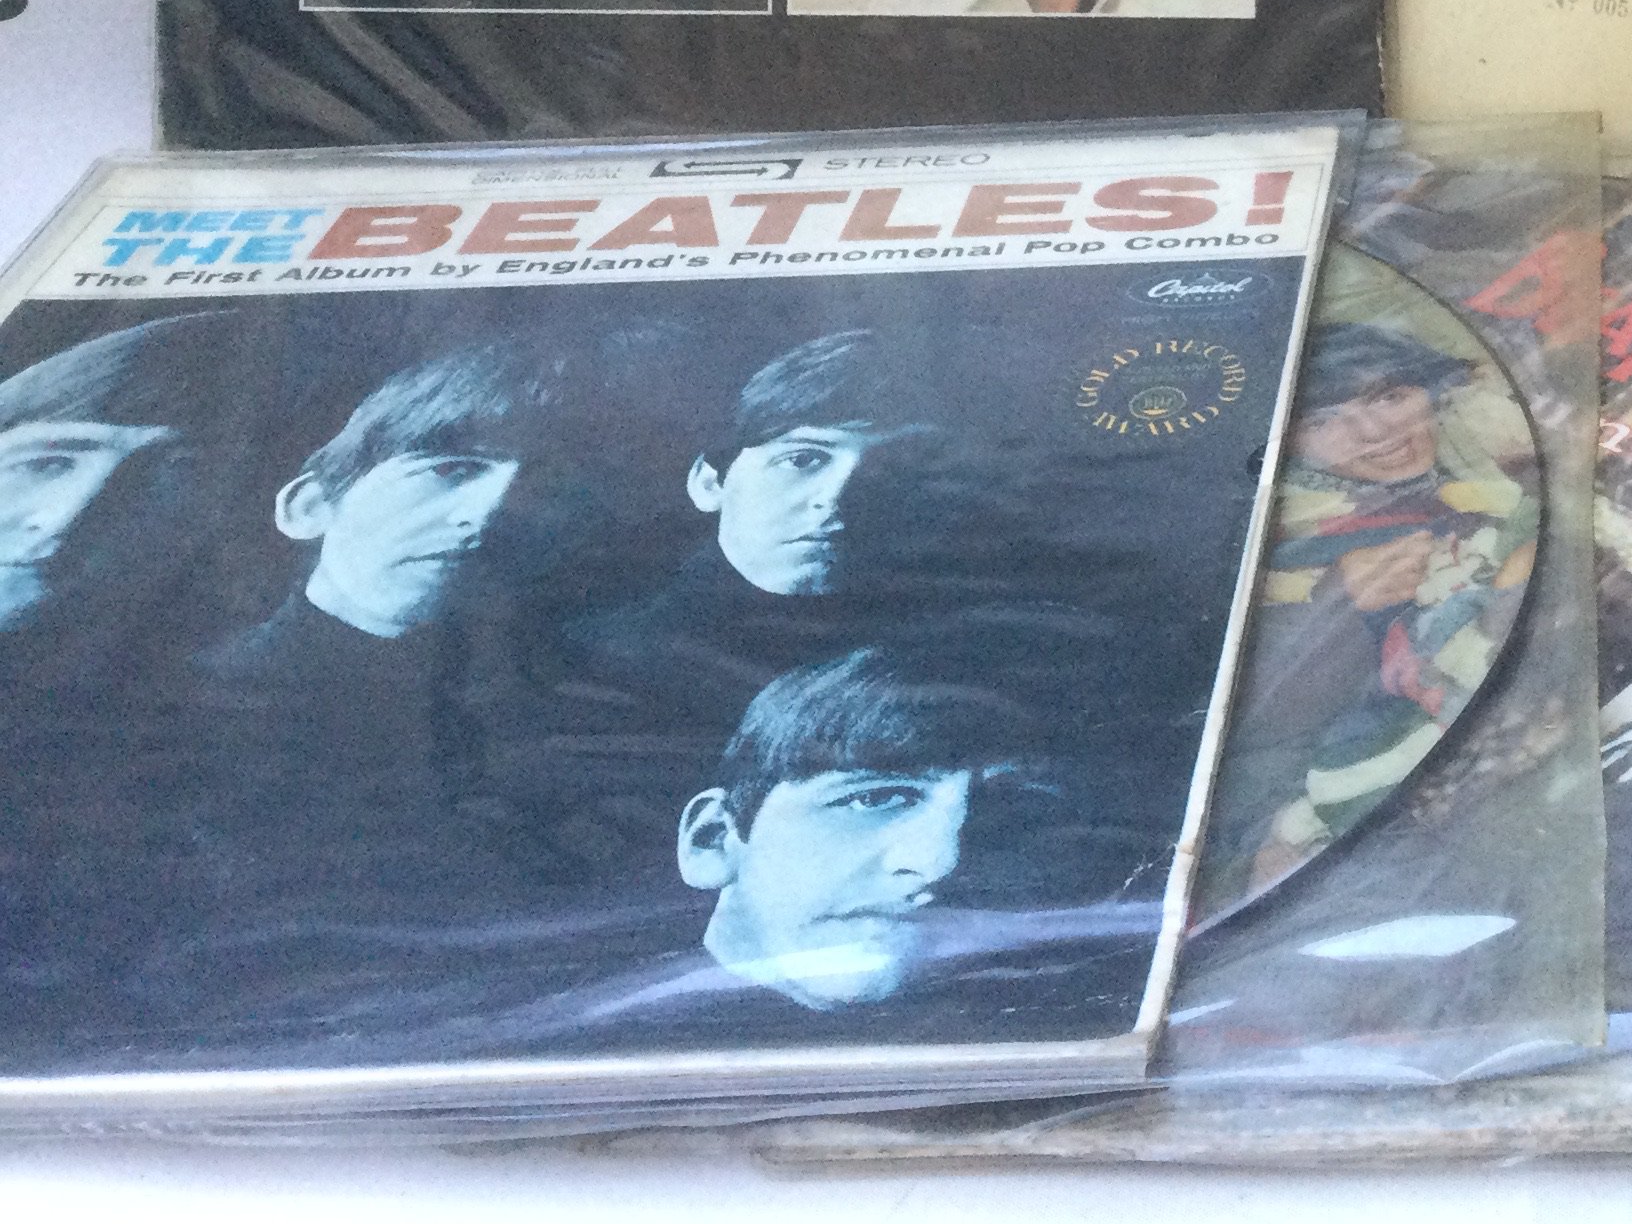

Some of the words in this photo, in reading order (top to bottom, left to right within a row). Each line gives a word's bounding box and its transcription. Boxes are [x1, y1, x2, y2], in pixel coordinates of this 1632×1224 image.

[823, 151, 990, 170] STEREO
[102, 234, 306, 267] THE
[308, 170, 1294, 260] BEATLES!
[113, 207, 326, 233] MEET
[75, 273, 148, 287] The
[164, 268, 262, 286] First
[275, 264, 411, 283] Album
[430, 261, 481, 279] by
[495, 253, 710, 276] England's
[729, 241, 1005, 266] Phenomenal
[1024, 237, 1106, 258] Pop
[1124, 231, 1280, 251] Combo
[1147, 275, 1253, 298] Capitol
